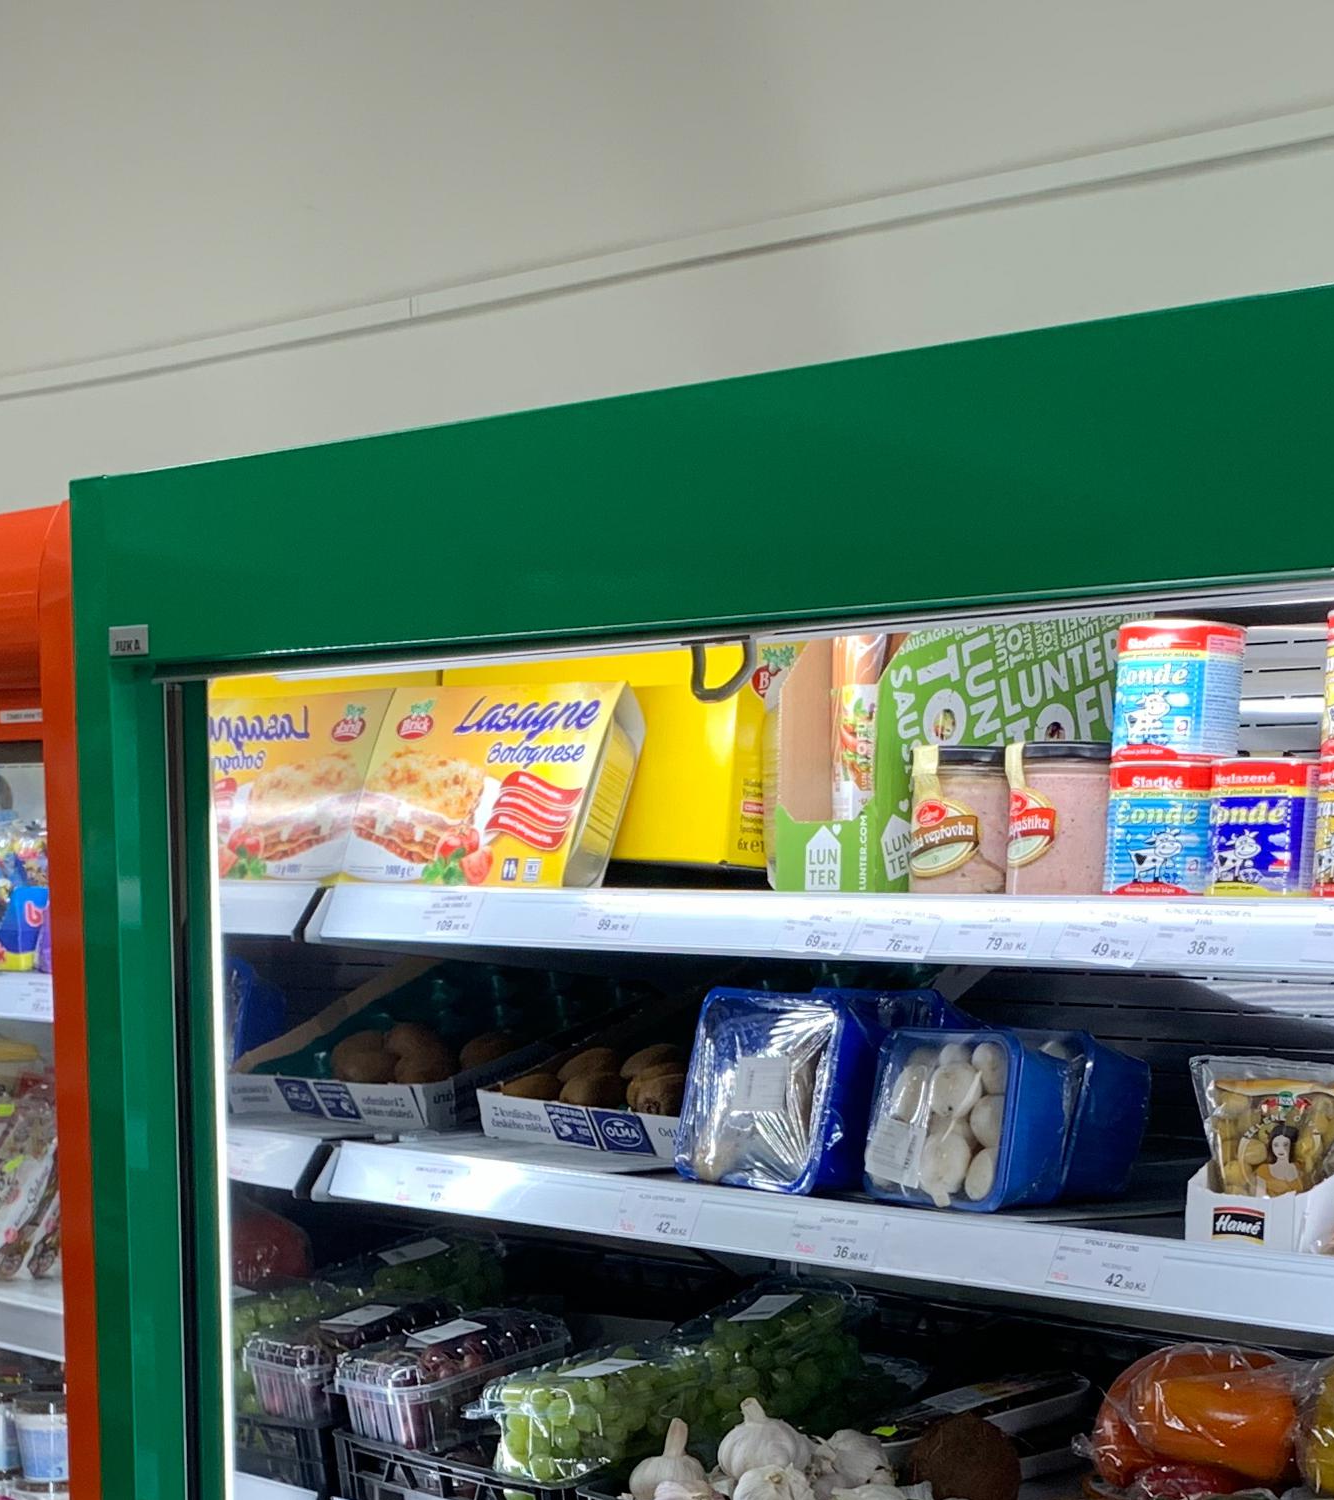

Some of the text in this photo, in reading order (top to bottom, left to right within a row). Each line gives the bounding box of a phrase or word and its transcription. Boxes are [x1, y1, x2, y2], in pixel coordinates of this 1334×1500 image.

[1000, 630, 1118, 718] LUNTER
[399, 718, 431, 735] Brick
[453, 695, 601, 742] Lasagne
[486, 741, 586, 769] Bolognese
[1131, 775, 1184, 790] Sladké
[1215, 773, 1276, 785] Neslazené
[1116, 800, 1200, 826] Condé
[808, 848, 838, 866] LUN
[858, 814, 868, 892] LUNTER.COM
[808, 869, 838, 886] TER
[605, 1125, 639, 1141] OLMA
[1215, 1214, 1262, 1235] Hamé
[1103, 1272, 1135, 1290] 42,90
